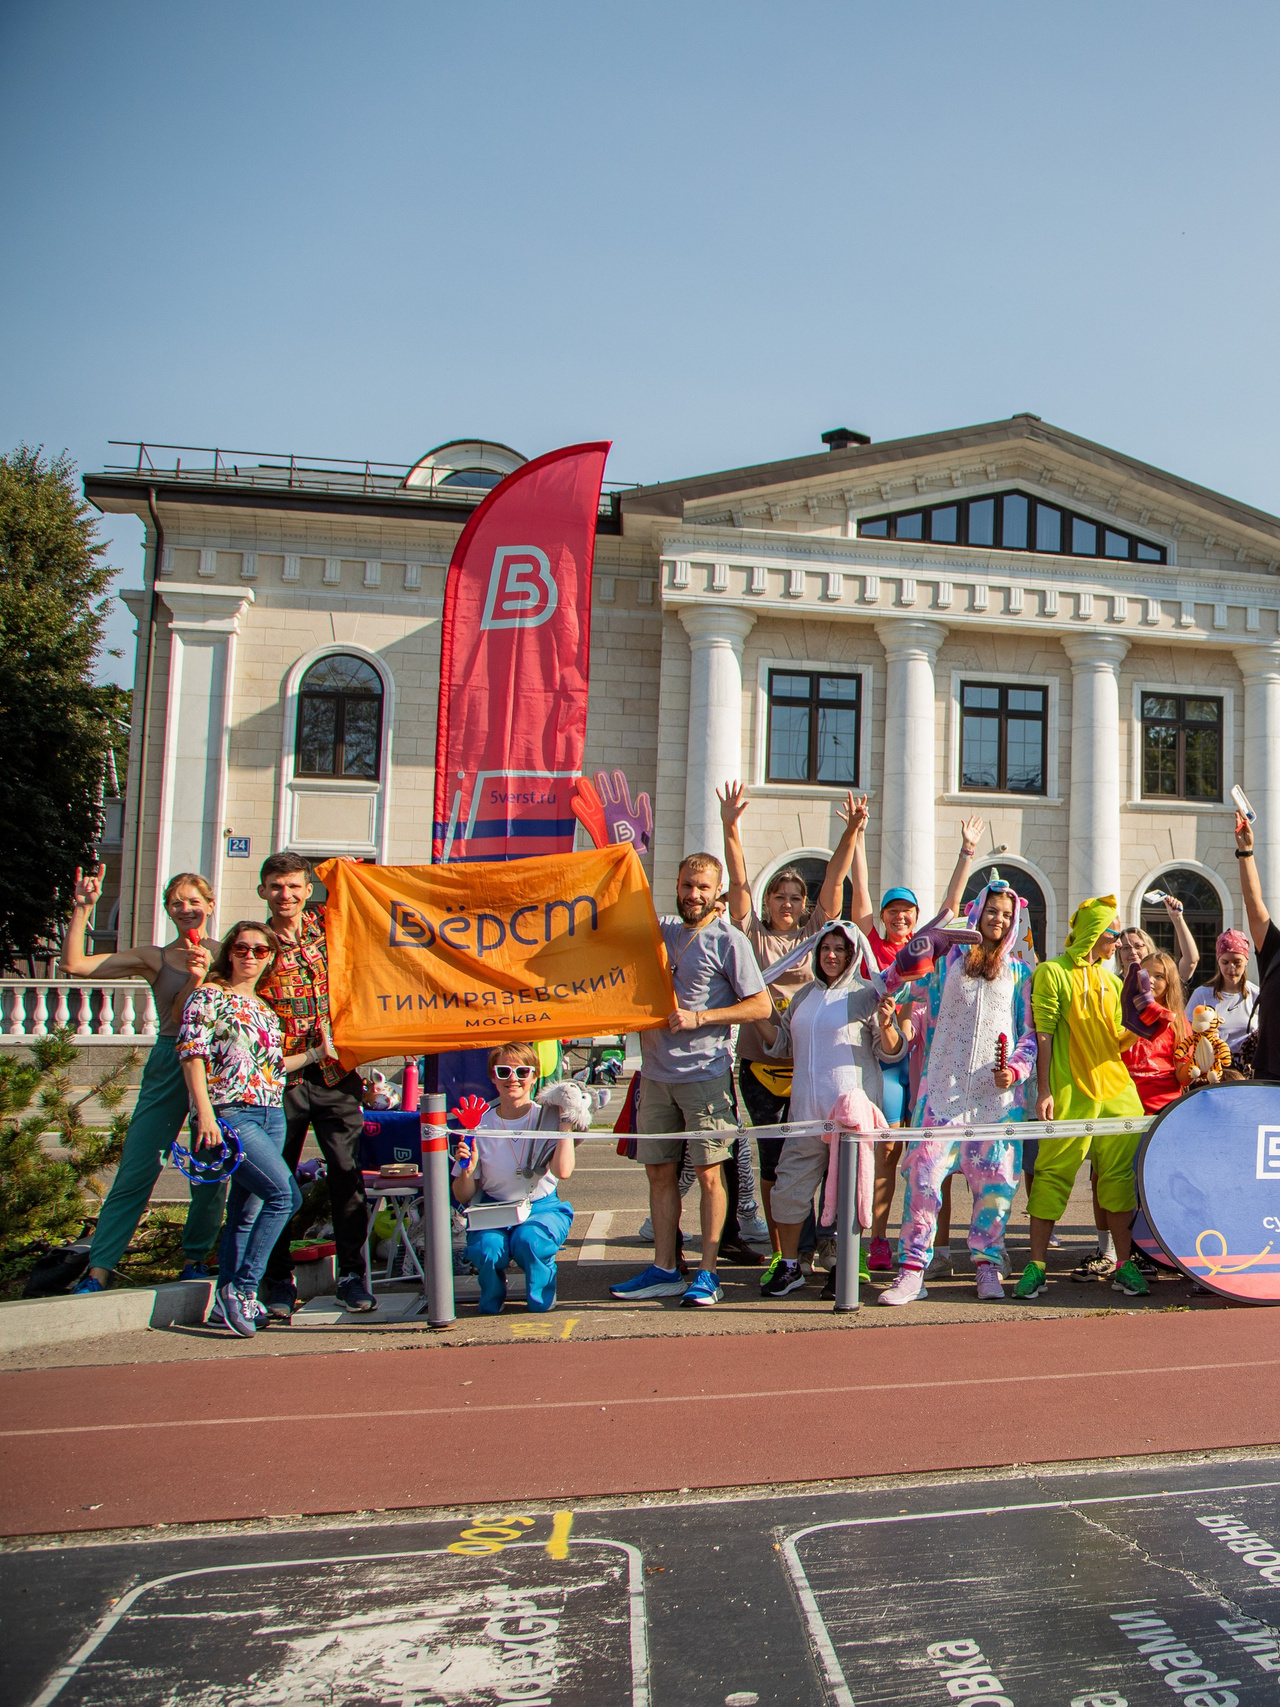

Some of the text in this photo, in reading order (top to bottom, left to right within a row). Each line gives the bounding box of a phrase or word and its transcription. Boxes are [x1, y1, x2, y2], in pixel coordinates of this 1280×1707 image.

[490, 790, 556, 804] 5verst.ru
[232, 839, 246, 850] 24
[377, 966, 627, 1012] ТИМИРЯЗЕВСКИЙ
[465, 1012, 551, 1028] МОСКВА
